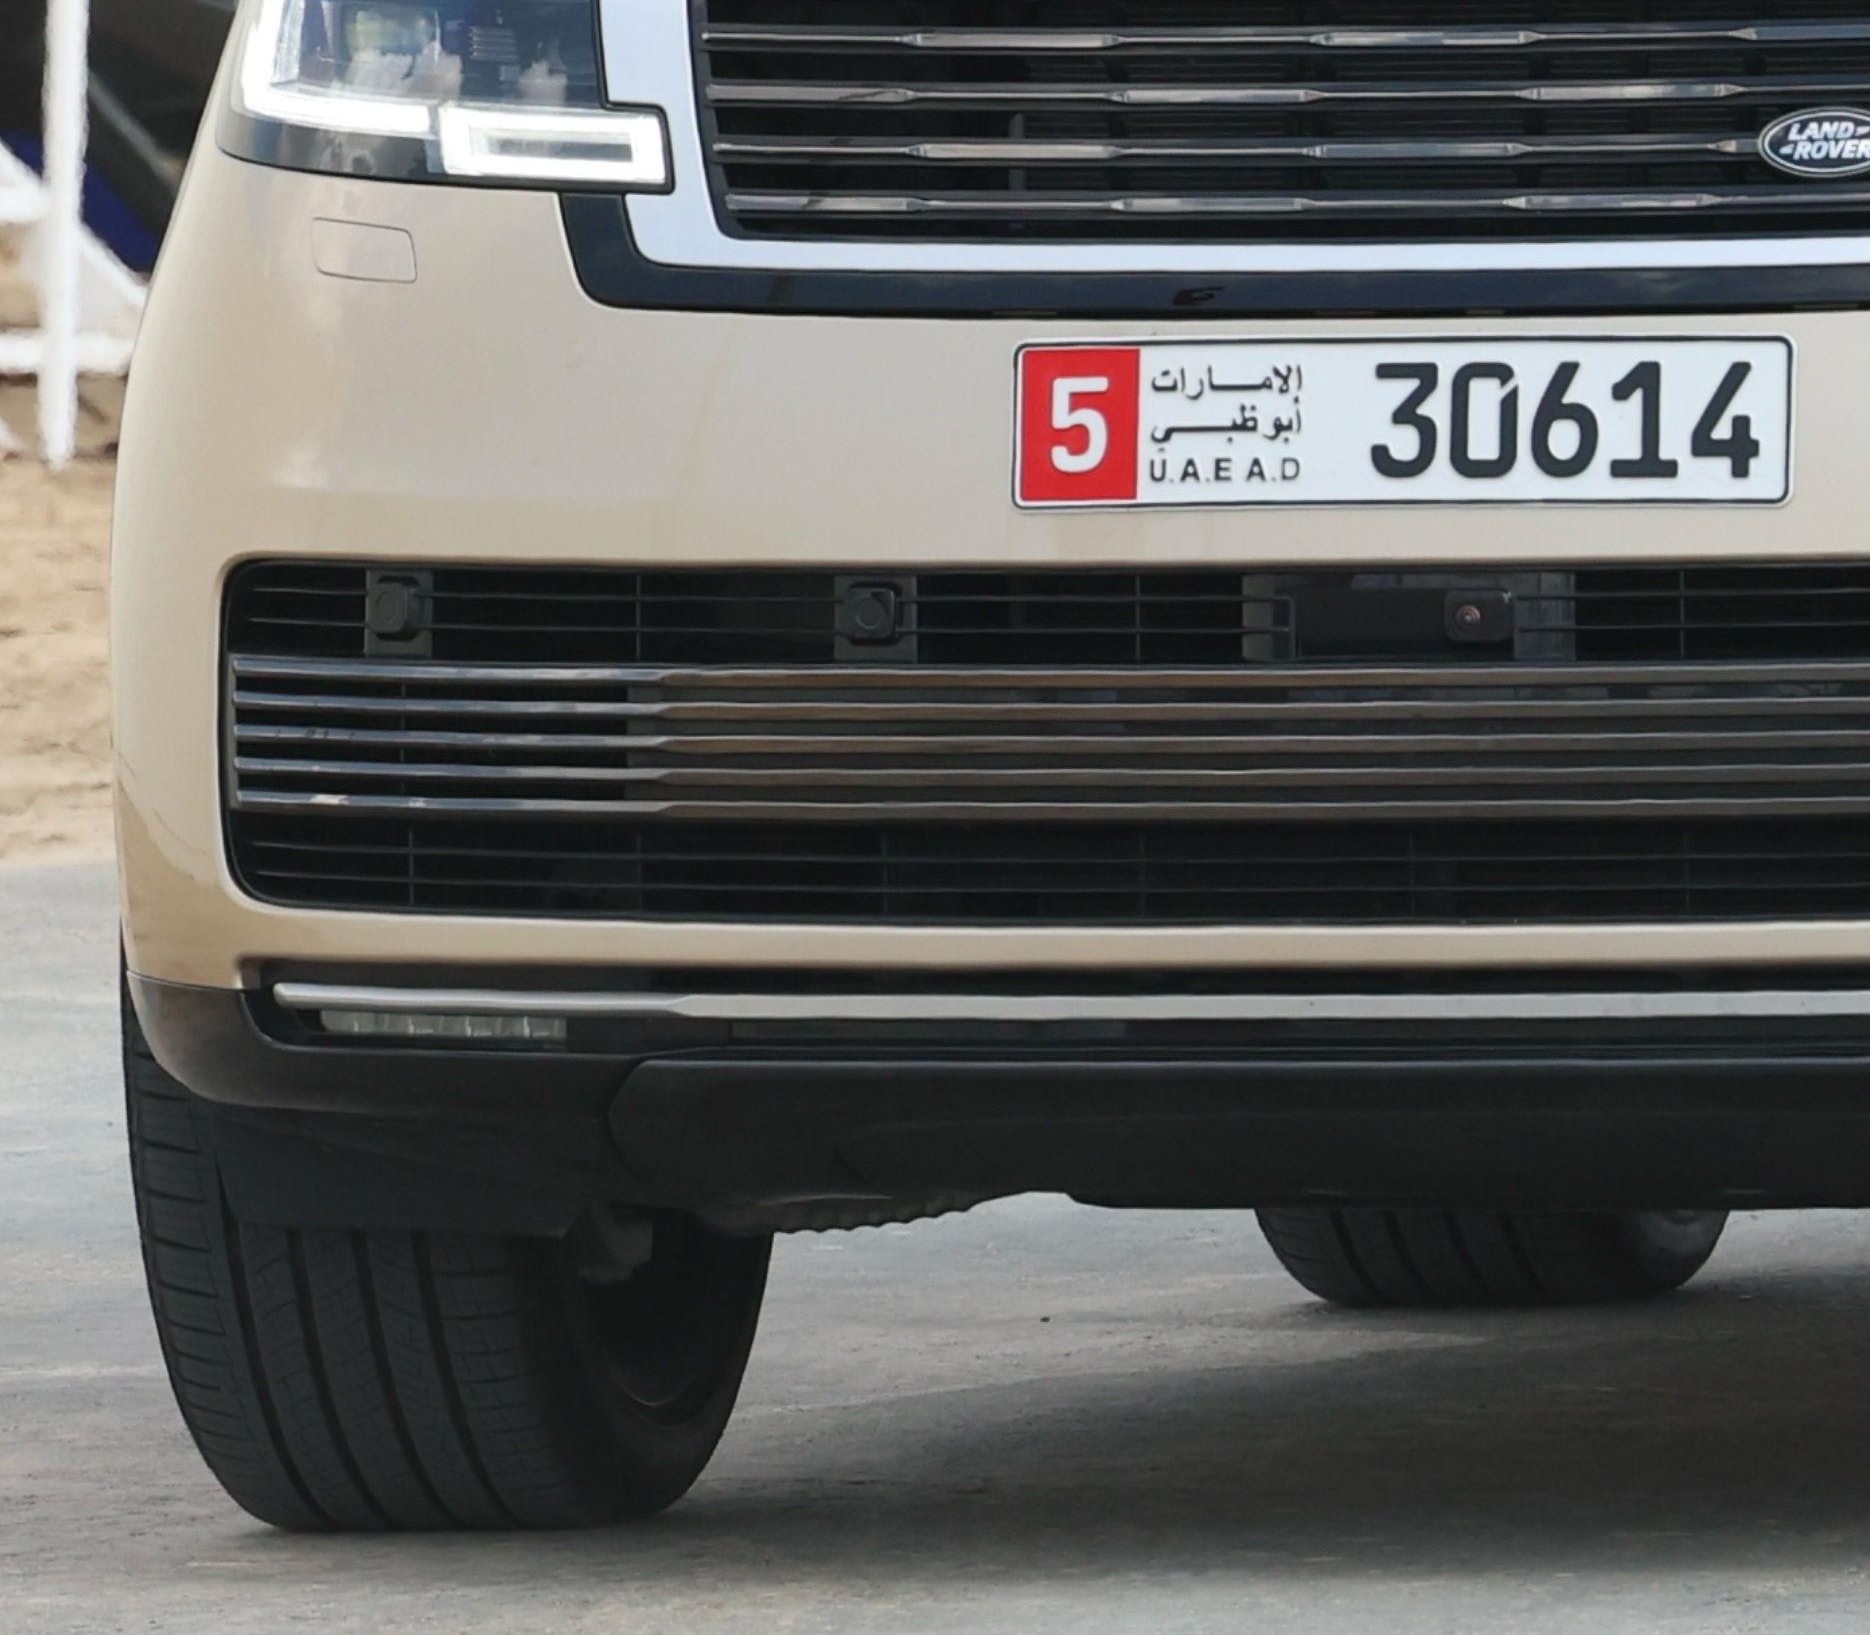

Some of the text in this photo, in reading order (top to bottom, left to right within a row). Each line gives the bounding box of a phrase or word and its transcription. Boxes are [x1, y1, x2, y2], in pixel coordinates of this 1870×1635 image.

[1787, 121, 1855, 142] LAND
[1049, 374, 1109, 473] 5
[1369, 360, 1762, 480] 30614
